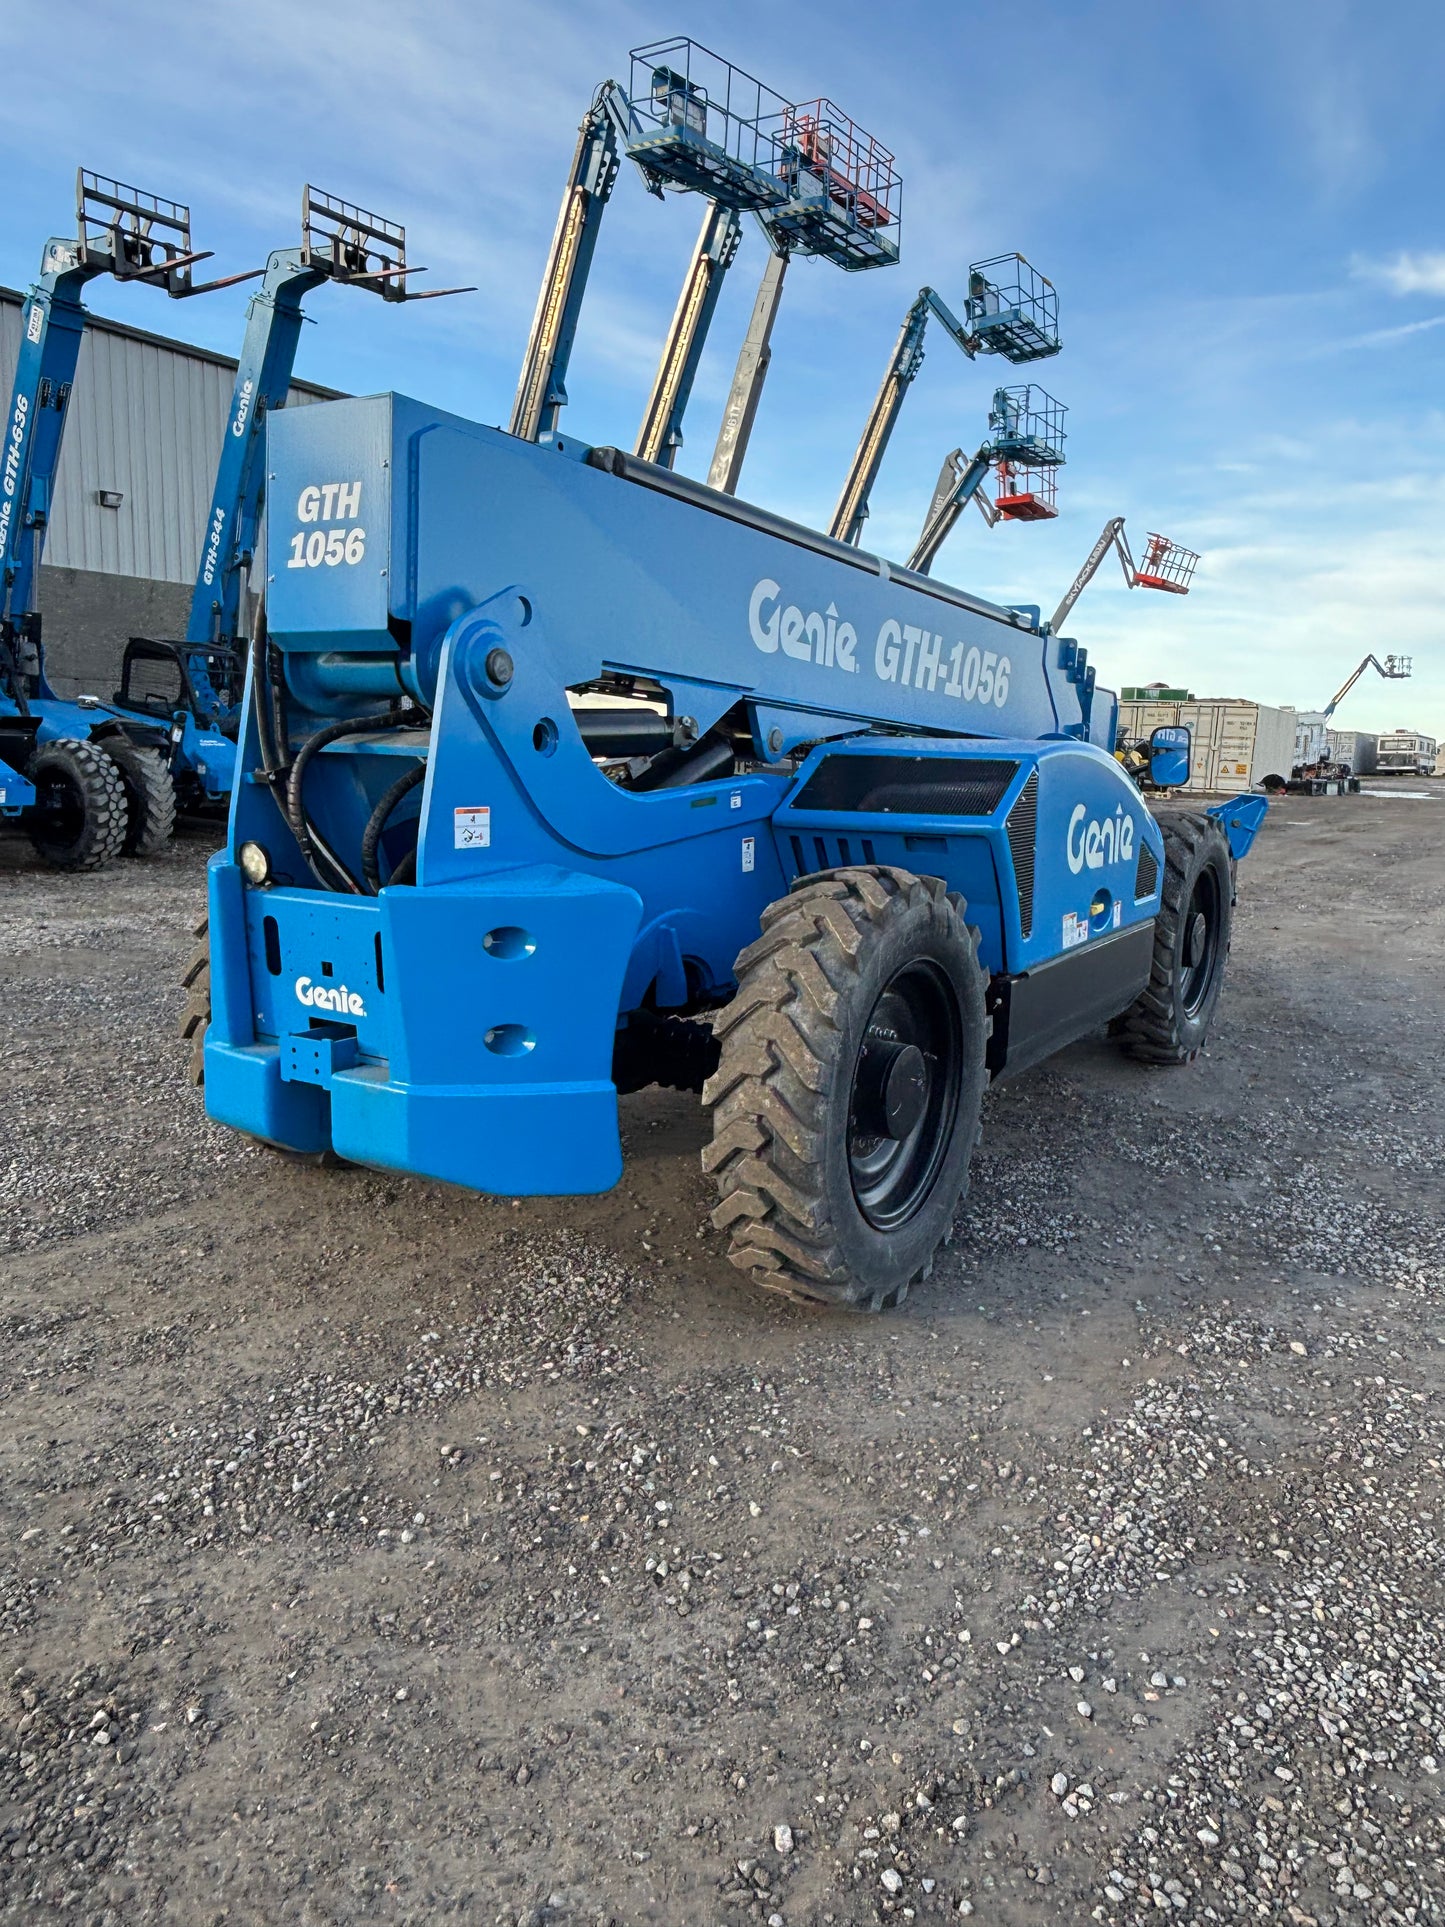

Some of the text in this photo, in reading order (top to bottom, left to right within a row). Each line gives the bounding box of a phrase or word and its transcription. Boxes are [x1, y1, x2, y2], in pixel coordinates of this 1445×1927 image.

[232, 379, 253, 438] Genie
[3, 393, 29, 497] GTH-636
[297, 481, 362, 523] GTH
[203, 506, 226, 586] GTH-844
[287, 527, 366, 569] 1056
[748, 578, 1011, 709] Genie GTH-1056
[1066, 802, 1134, 875] Genie
[295, 976, 365, 1017] Genie
